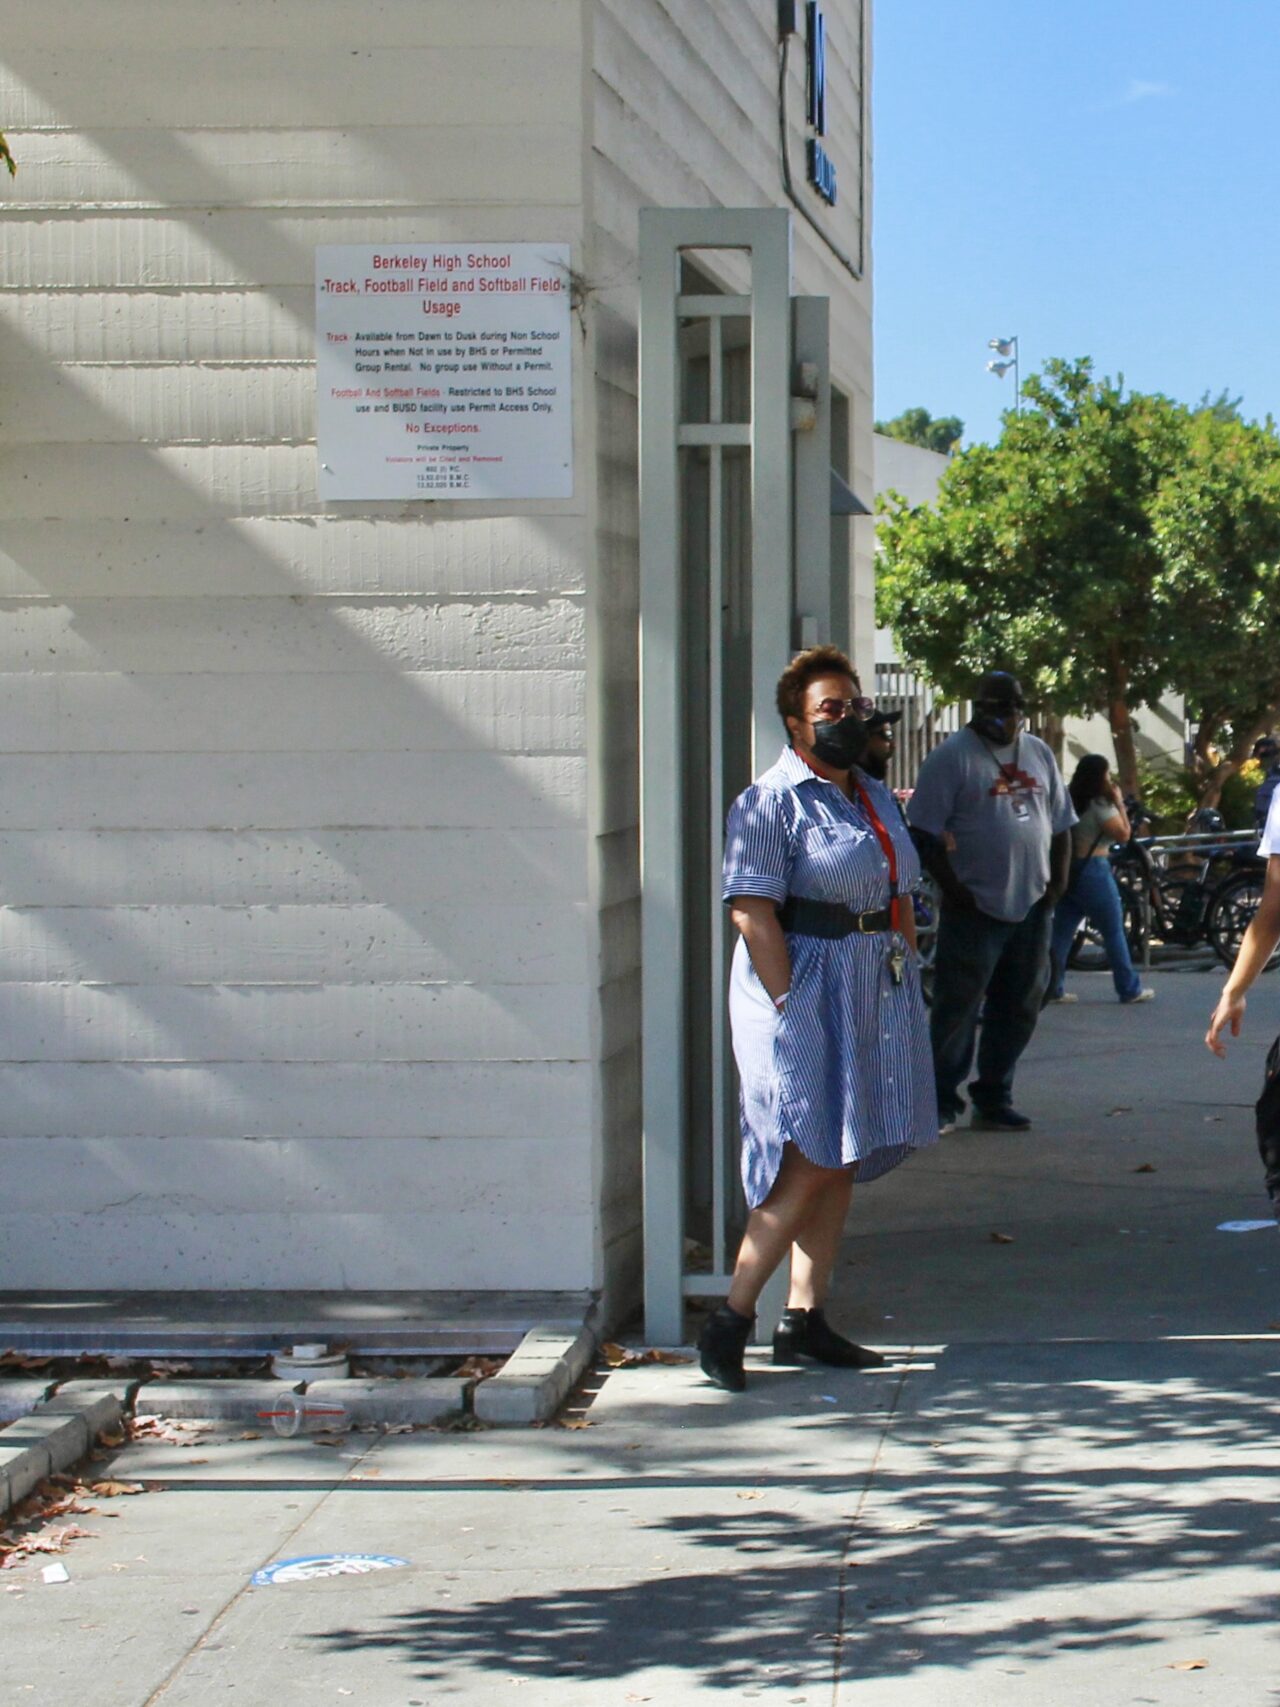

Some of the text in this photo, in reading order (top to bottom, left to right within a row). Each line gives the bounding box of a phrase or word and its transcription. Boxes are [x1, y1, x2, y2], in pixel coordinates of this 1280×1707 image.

[373, 254, 511, 272] Berkeley High School
[324, 277, 560, 294] Track, Football Field and Softball Field
[423, 300, 461, 318] Usage
[326, 331, 560, 342] Track Available from Dawn to Dusk during Non School
[355, 346, 542, 357] Hours when Not in use by BHS or Permitted
[355, 362, 381, 373] Group
[420, 362, 432, 371] No
[435, 363, 459, 373] group
[462, 363, 477, 371] use
[480, 361, 513, 371] Without
[516, 363, 521, 371] a
[331, 386, 556, 398] Football And Softball Fields Restricted to BHS School
[355, 404, 370, 412] use
[374, 403, 390, 412] and
[392, 402, 417, 412] BUSD
[420, 402, 447, 414] facility
[451, 404, 465, 412] use
[469, 402, 496, 412] Permit
[499, 402, 529, 412] Access
[405, 422, 481, 435] No Exceptions.
[442, 444, 469, 452] Property
